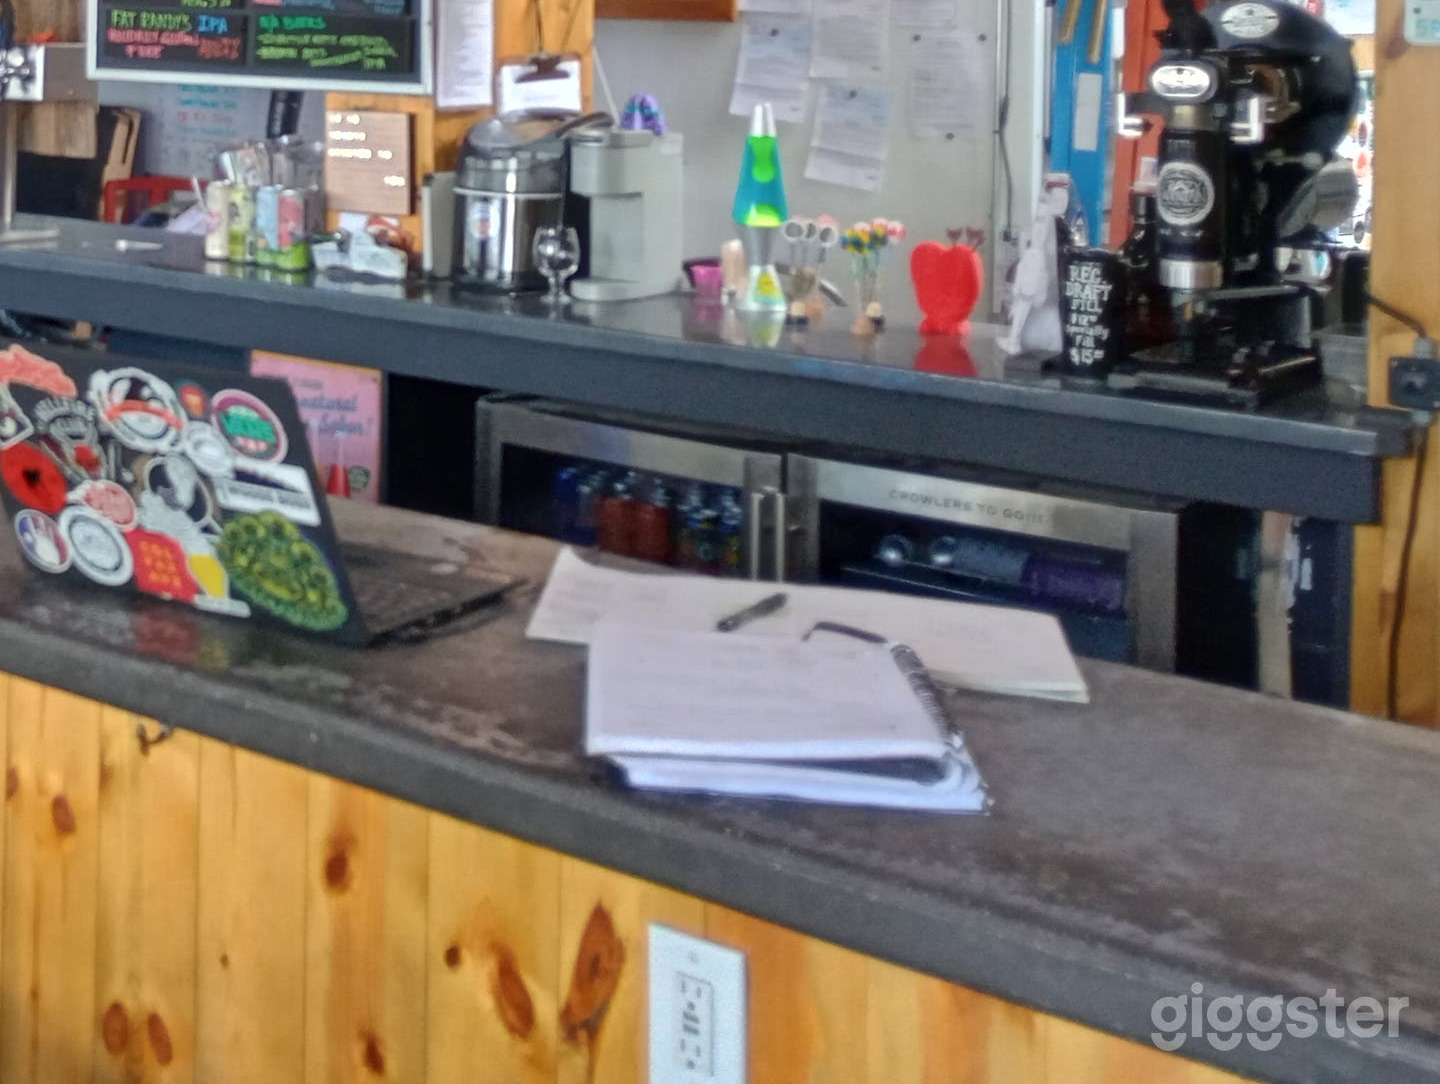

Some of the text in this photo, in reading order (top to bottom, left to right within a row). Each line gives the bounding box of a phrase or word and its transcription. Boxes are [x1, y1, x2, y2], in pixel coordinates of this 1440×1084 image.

[197, 14, 228, 34] IPA
[1065, 280, 1113, 301] DRAFT
[888, 489, 973, 512] CROWLERS
[975, 502, 998, 517] TO
